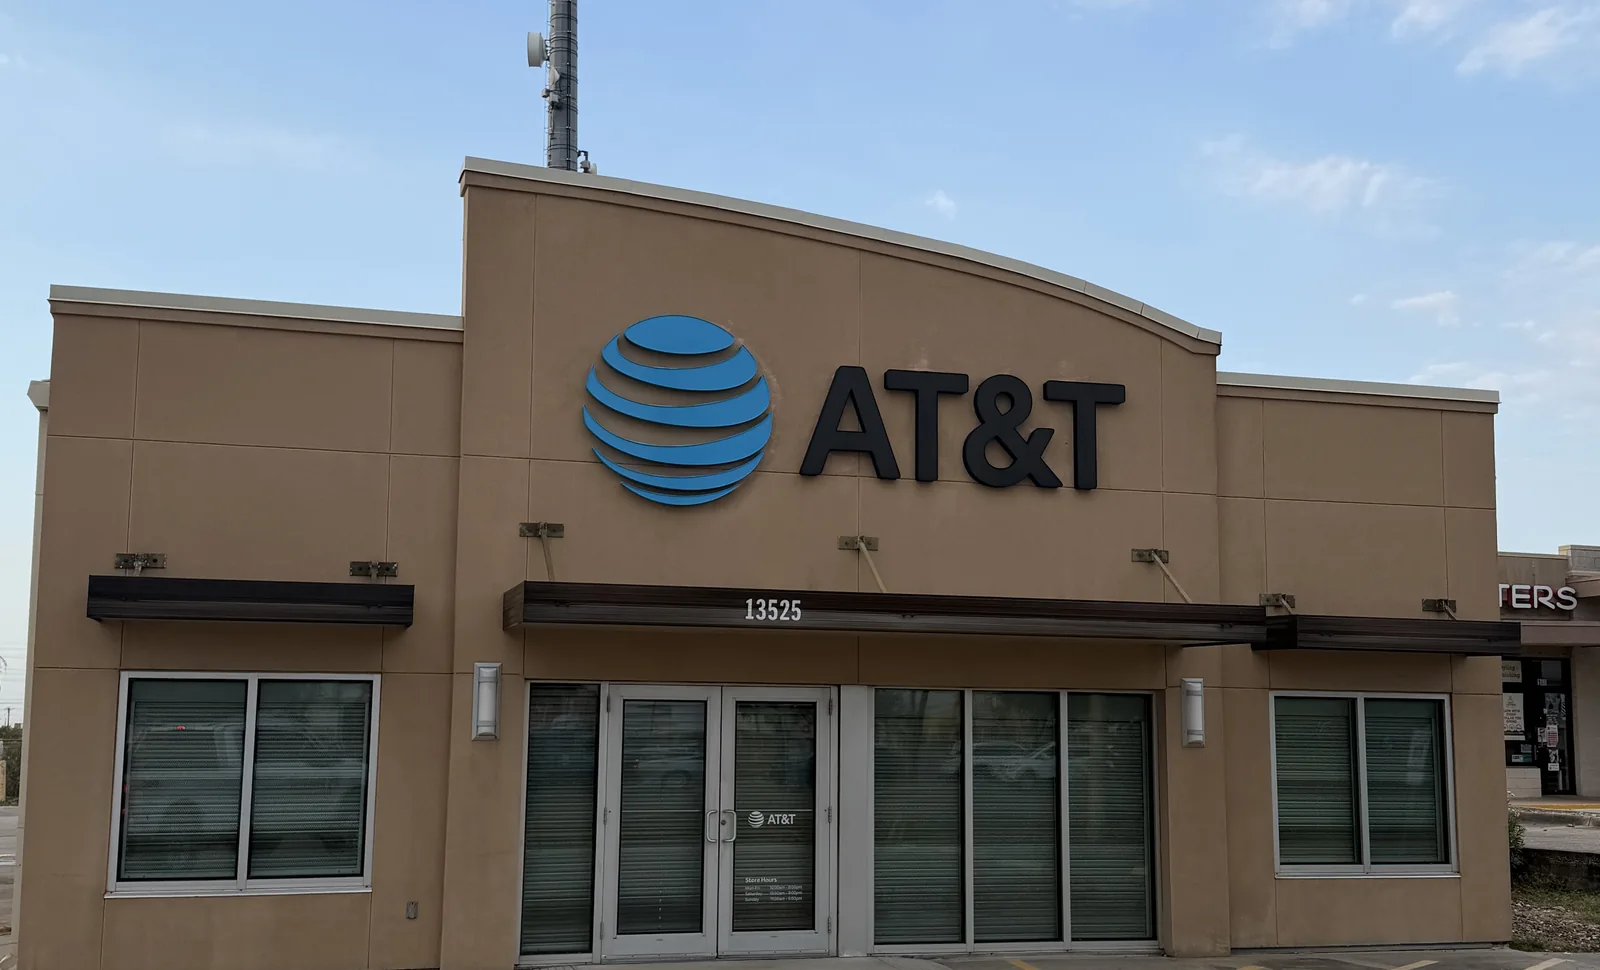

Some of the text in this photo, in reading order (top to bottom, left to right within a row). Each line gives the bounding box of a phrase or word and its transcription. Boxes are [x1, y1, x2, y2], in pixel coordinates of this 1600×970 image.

[799, 365, 1126, 490] AT&T
[745, 598, 802, 621] 13525
[767, 813, 796, 825] AT&T
